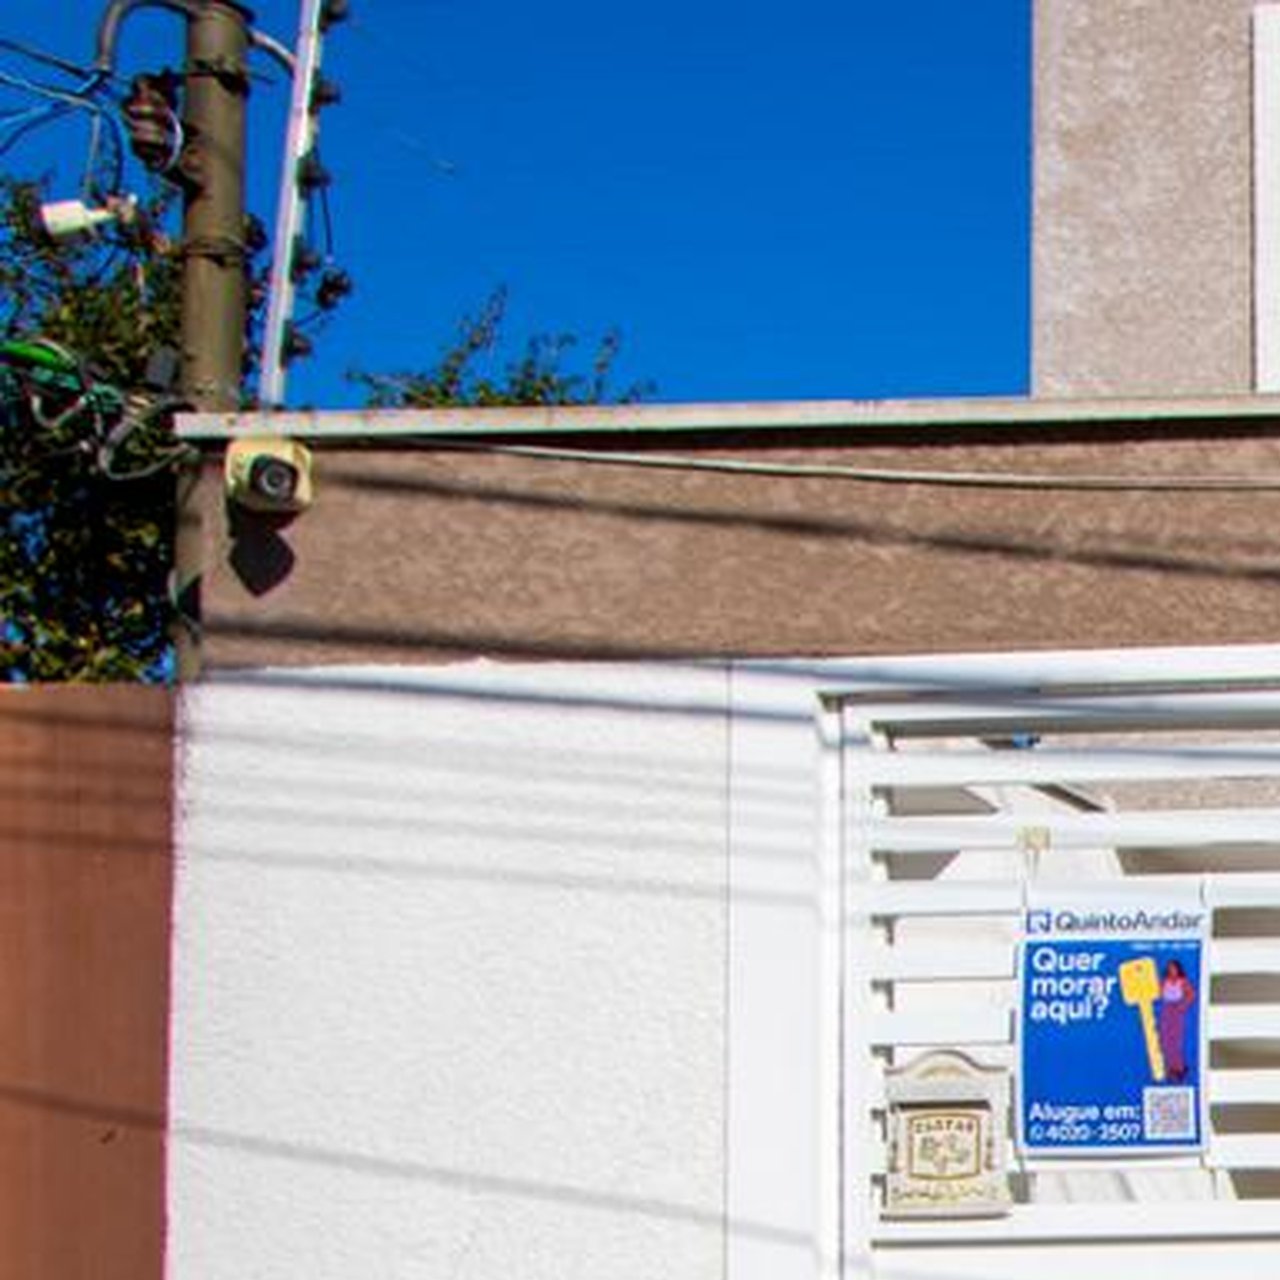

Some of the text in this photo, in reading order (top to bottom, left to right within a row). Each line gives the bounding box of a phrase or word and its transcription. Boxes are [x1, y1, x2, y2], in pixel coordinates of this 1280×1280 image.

[1055, 910, 1203, 932] QuintoAndar
[1032, 946, 1106, 973] Quer
[1031, 975, 1117, 996] morar
[1030, 996, 1109, 1025] aqui?
[1028, 1101, 1141, 1123] Alugue em:
